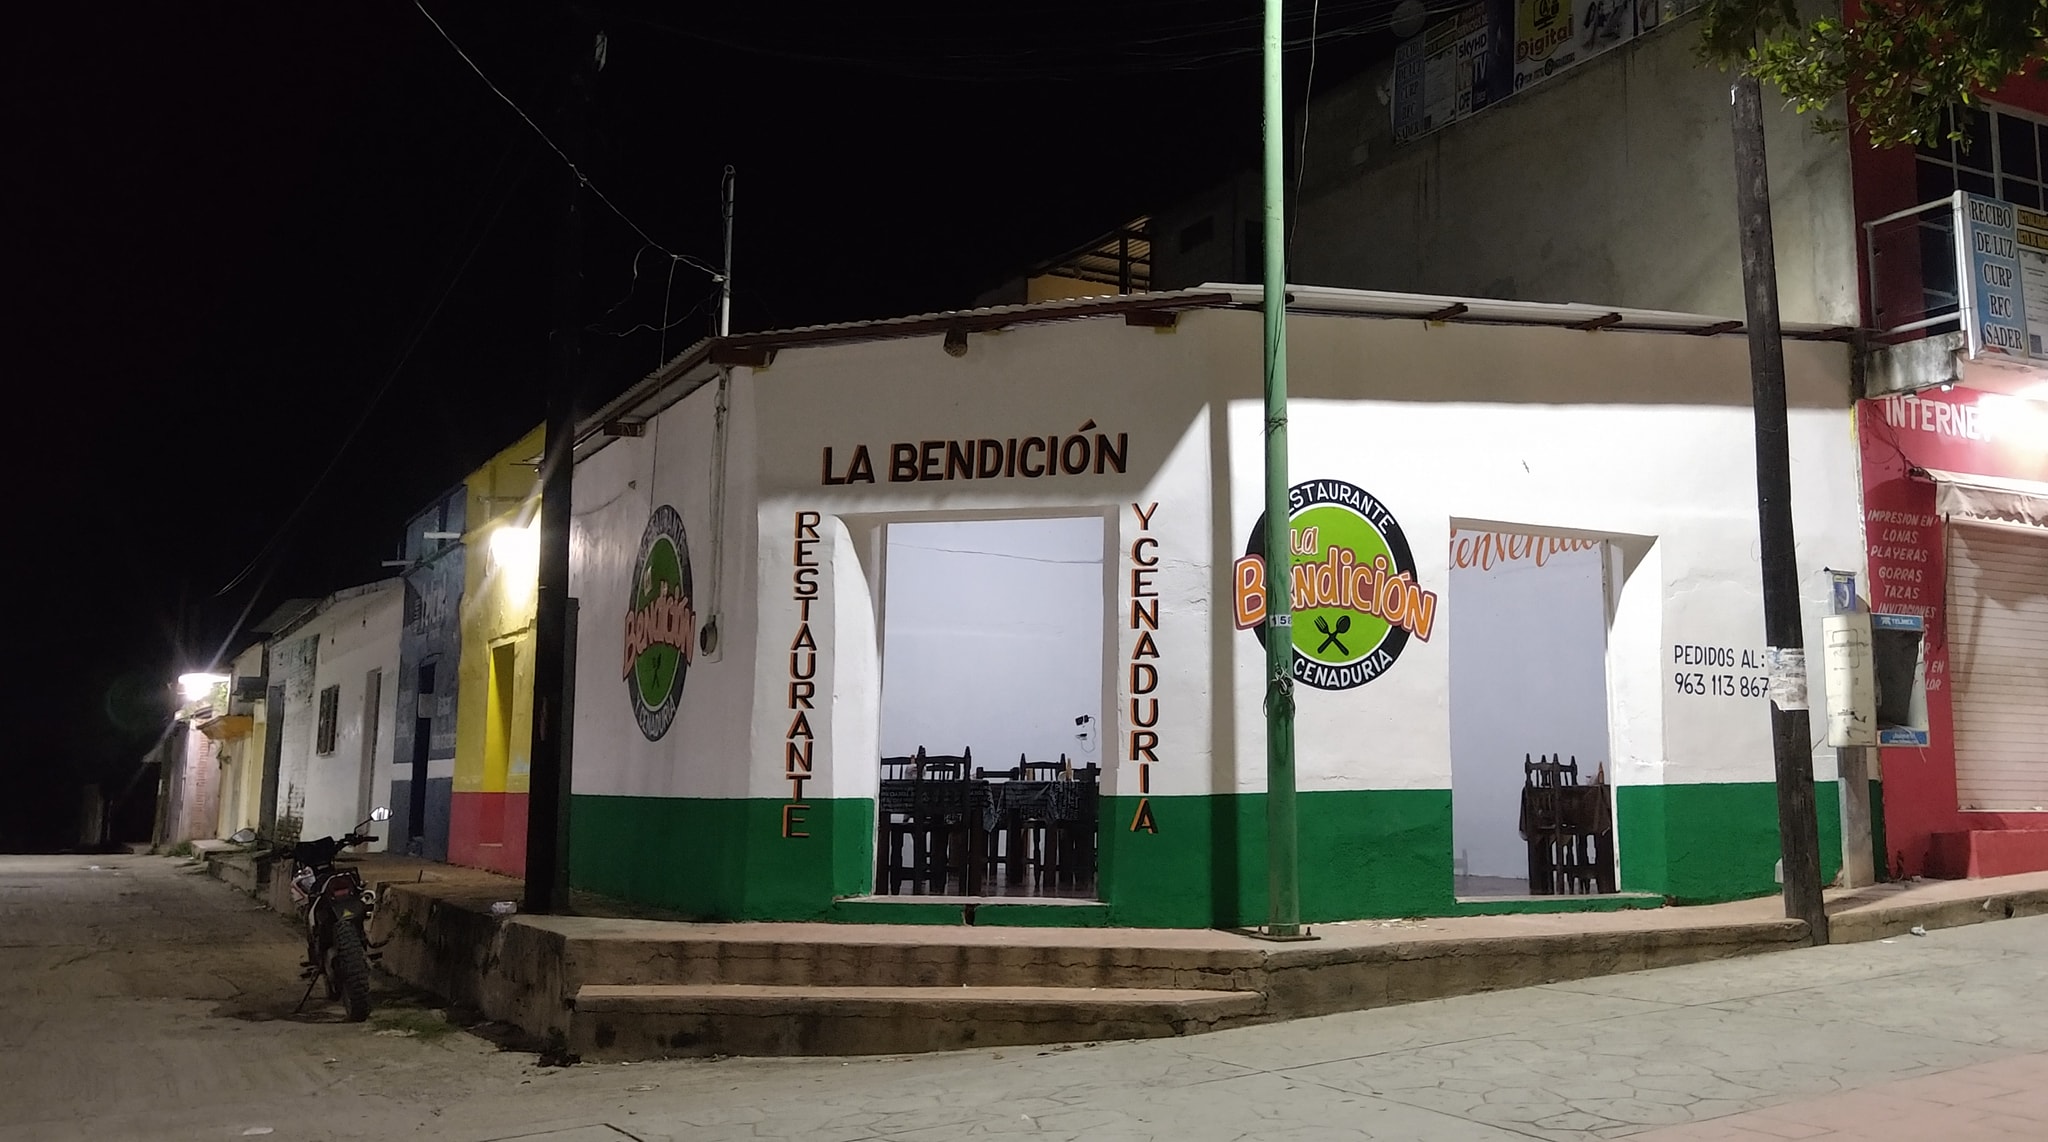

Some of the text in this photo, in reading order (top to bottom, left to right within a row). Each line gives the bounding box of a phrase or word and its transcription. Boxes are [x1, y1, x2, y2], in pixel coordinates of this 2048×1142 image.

[1516, 14, 1574, 63] Digital
[1970, 201, 2011, 229] RECIBO
[1976, 231, 1991, 252] DE
[1994, 235, 2014, 259] LUZ
[1984, 263, 2012, 288] CURP
[1990, 294, 2011, 318] RFC
[1986, 323, 2022, 350] SADER
[1885, 396, 1991, 442] INTERNE
[821, 419, 1128, 485] LA BENDICIÓN
[1289, 482, 1395, 534] STAURANTE
[1867, 509, 1933, 527] IMPRESION EN
[1882, 527, 1919, 544] LONAS
[1870, 545, 1928, 563] PLAYERAS
[1878, 566, 1923, 583] GORRAS
[1884, 584, 1920, 599] TAZAS
[1293, 649, 1393, 688] CENADURIA
[1674, 645, 1735, 668] PEDIDOS
[1740, 649, 1766, 669] AL:
[780, 510, 821, 839] RESTAURANTE
[1674, 672, 1770, 699] 963 113 867
